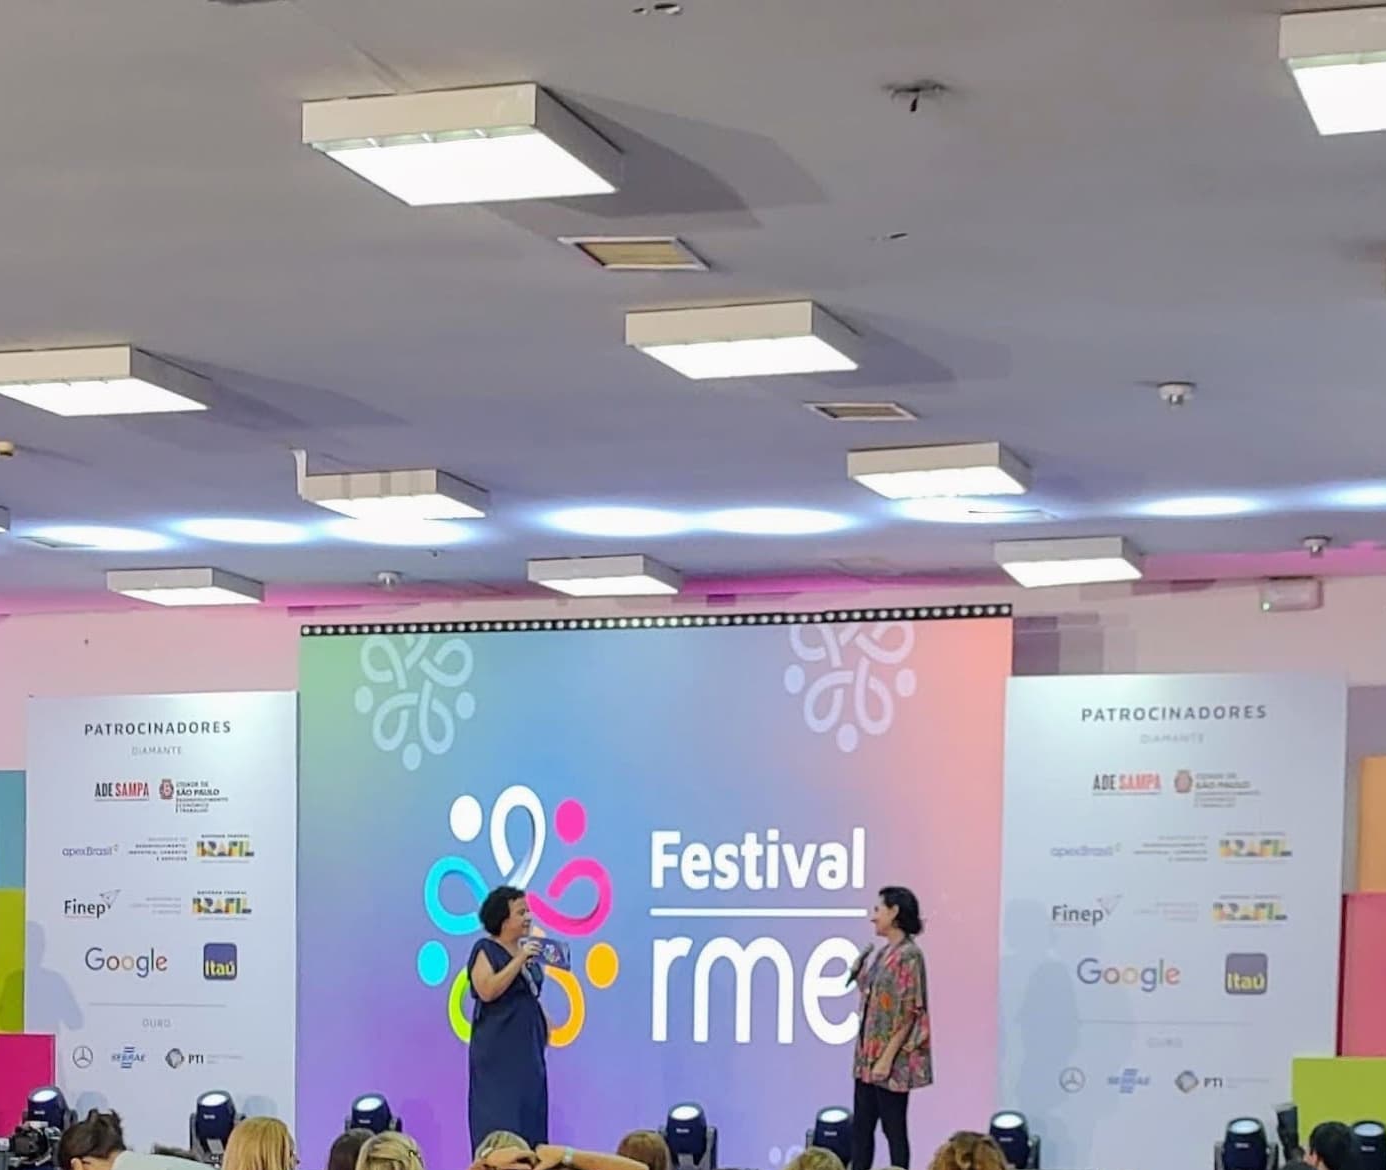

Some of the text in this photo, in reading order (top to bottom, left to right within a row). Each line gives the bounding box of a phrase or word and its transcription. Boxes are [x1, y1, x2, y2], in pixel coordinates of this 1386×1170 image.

[1081, 704, 1268, 723] PATROCINADORES
[84, 720, 232, 737] PATROCINADORES
[131, 746, 183, 757] DIAMANTE
[94, 781, 150, 797] ADE SAMPA
[1092, 772, 1162, 791] ADE SAMPA
[176, 787, 220, 797] SÃO PAULO
[651, 827, 866, 890] Festival
[64, 898, 106, 919] Finep
[1052, 904, 1105, 927] Finep
[85, 947, 168, 978] Google
[205, 961, 236, 976] Itaú
[1077, 957, 1181, 993] Google
[1227, 971, 1265, 990] Itaú
[651, 936, 860, 1045] rme
[188, 1053, 205, 1065] PTI
